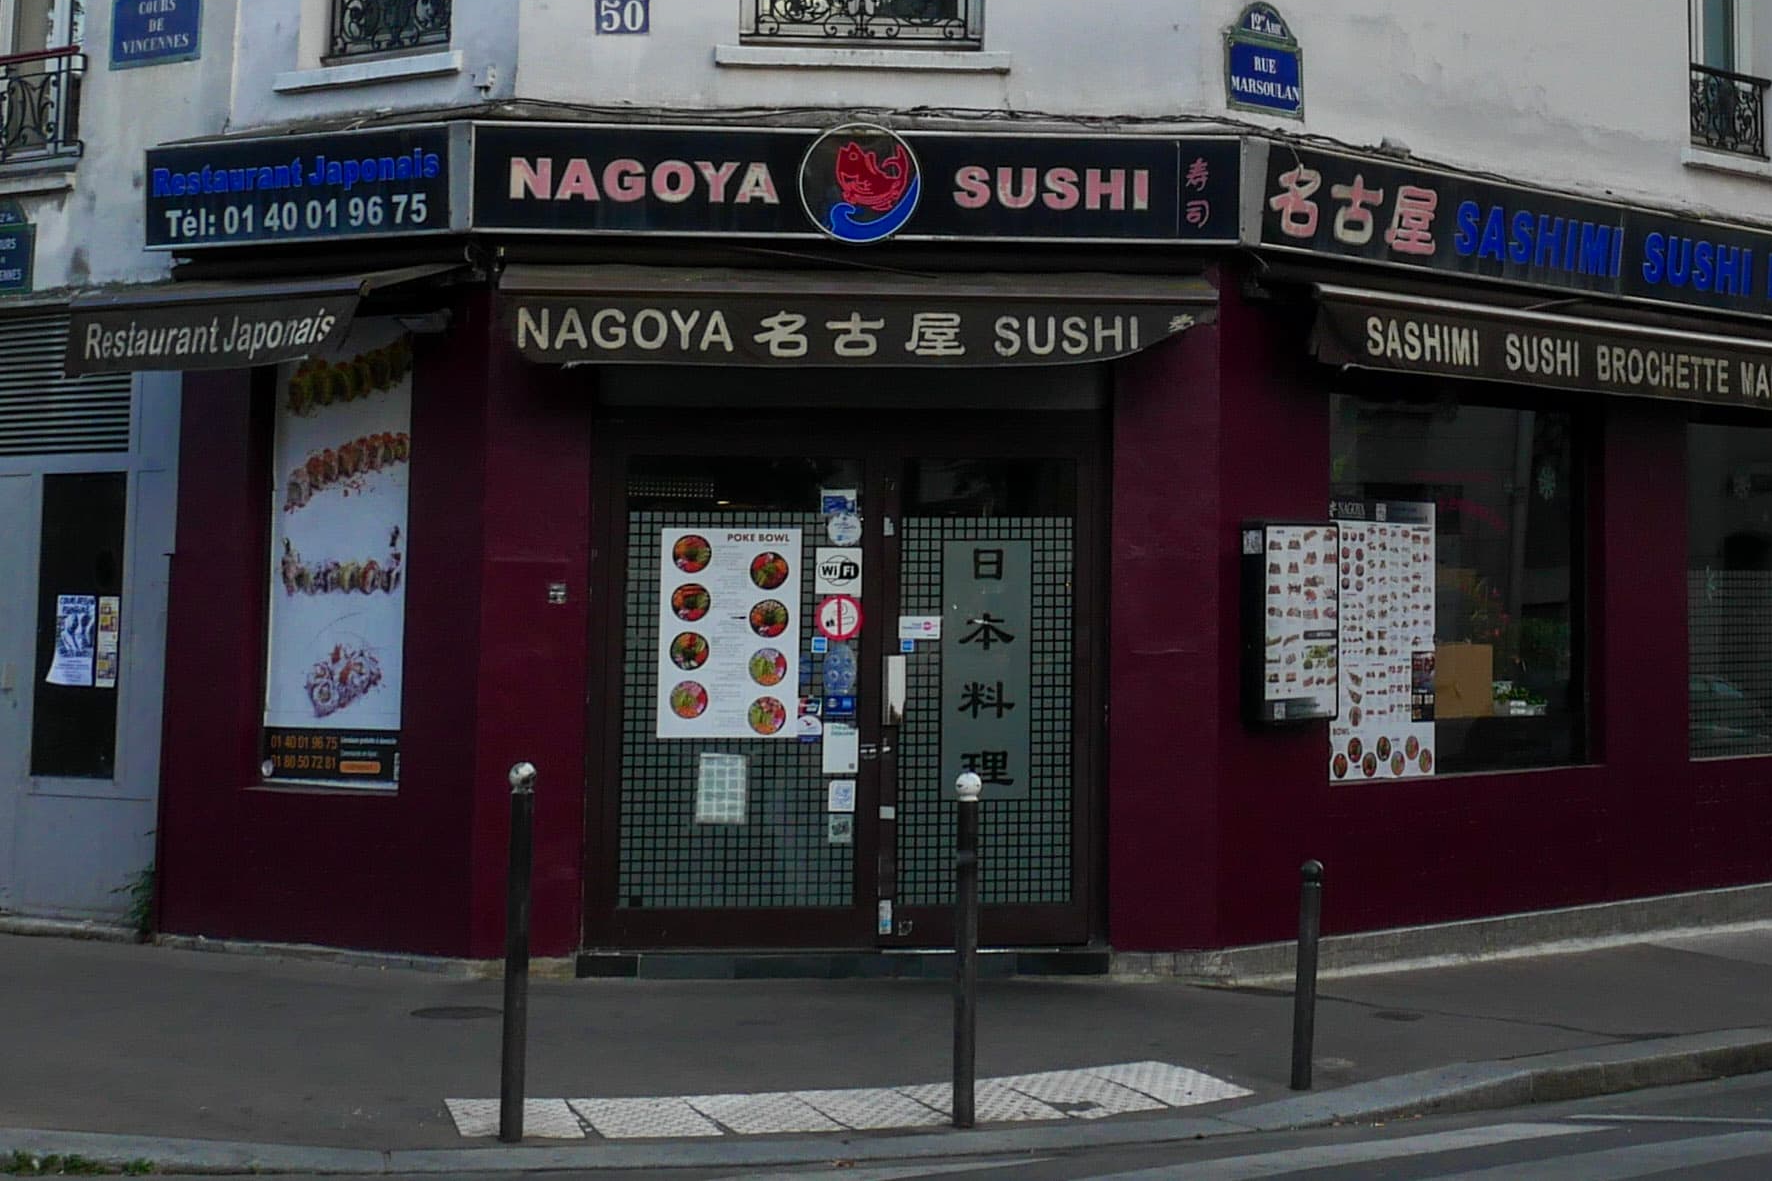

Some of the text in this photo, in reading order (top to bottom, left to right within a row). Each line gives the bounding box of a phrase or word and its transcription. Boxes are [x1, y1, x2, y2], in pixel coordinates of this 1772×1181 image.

[148, 18, 165, 32] DE
[601, 0, 645, 31] 50
[122, 33, 189, 54] VINCENNES
[1254, 56, 1276, 74] RUE
[1231, 75, 1300, 101] MARSOULAN
[152, 147, 440, 198] Restaurant Japonais
[509, 157, 1149, 211] NAGOYA SUSHI
[165, 192, 428, 238] Tél: 01 40 01 96 75
[1269, 168, 1438, 256] 名古屋
[1454, 200, 1624, 278] SASHIMI
[1642, 232, 1752, 297] SUSHI
[84, 307, 336, 360] Restaurant Japonais
[517, 307, 734, 353] NAGOYA
[753, 310, 966, 358] 名古屋
[994, 315, 1139, 357] SUSHI
[1366, 317, 1480, 367] SASHIMI
[1505, 332, 1580, 377] SUSHI
[1597, 345, 1730, 394] BROCHETTE
[727, 533, 790, 542] POKE BOWL
[958, 548, 1015, 786] 日本料理
